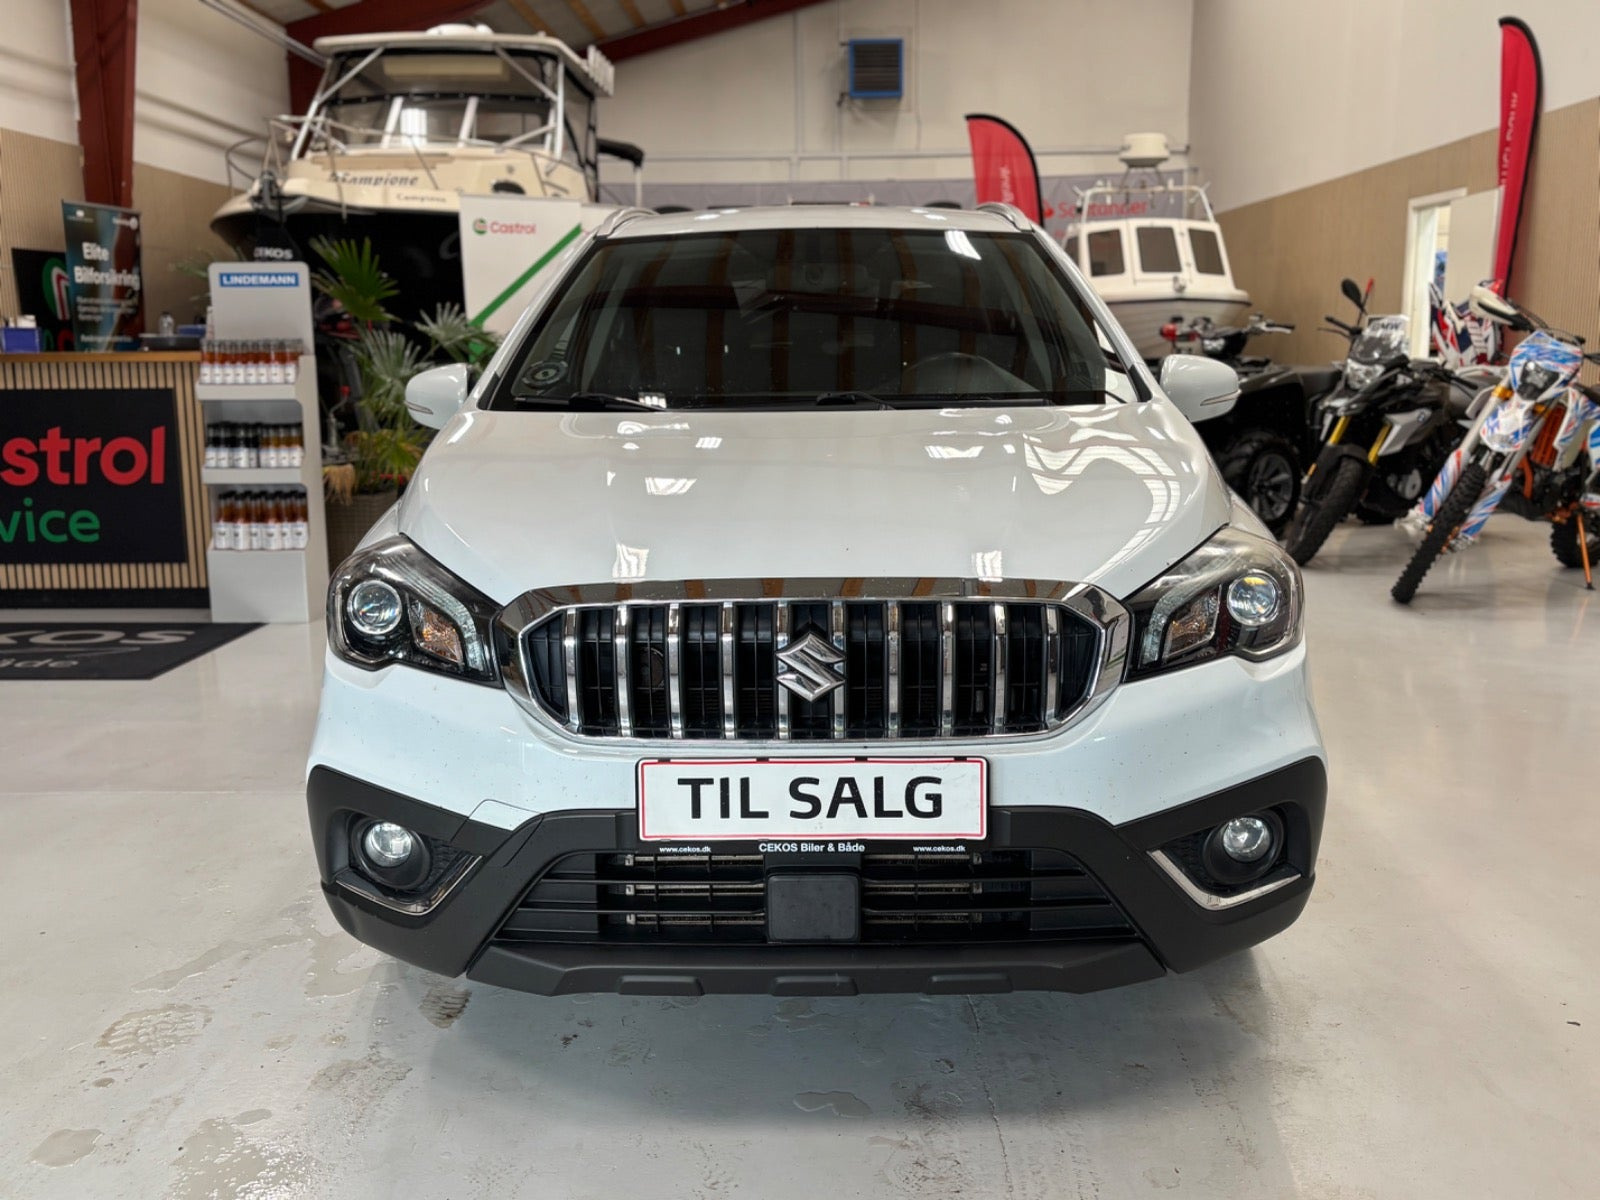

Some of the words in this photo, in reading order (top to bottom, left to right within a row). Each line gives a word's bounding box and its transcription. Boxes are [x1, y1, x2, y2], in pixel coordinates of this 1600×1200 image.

[1057, 200, 1148, 219] Satander
[490, 219, 537, 236] Castrol
[82, 241, 110, 261] Elite
[222, 275, 297, 285] LINDEMANN
[0, 426, 166, 486] strol
[0, 498, 99, 542] vice
[677, 776, 768, 819] TIL
[788, 776, 943, 819] SALG
[659, 845, 712, 854] www.cekos.dk
[758, 843, 799, 853] CEKOS
[801, 842, 825, 852] Biler
[827, 842, 836, 852] &
[837, 841, 866, 852] Både
[912, 845, 966, 853] www.cekos.dk
